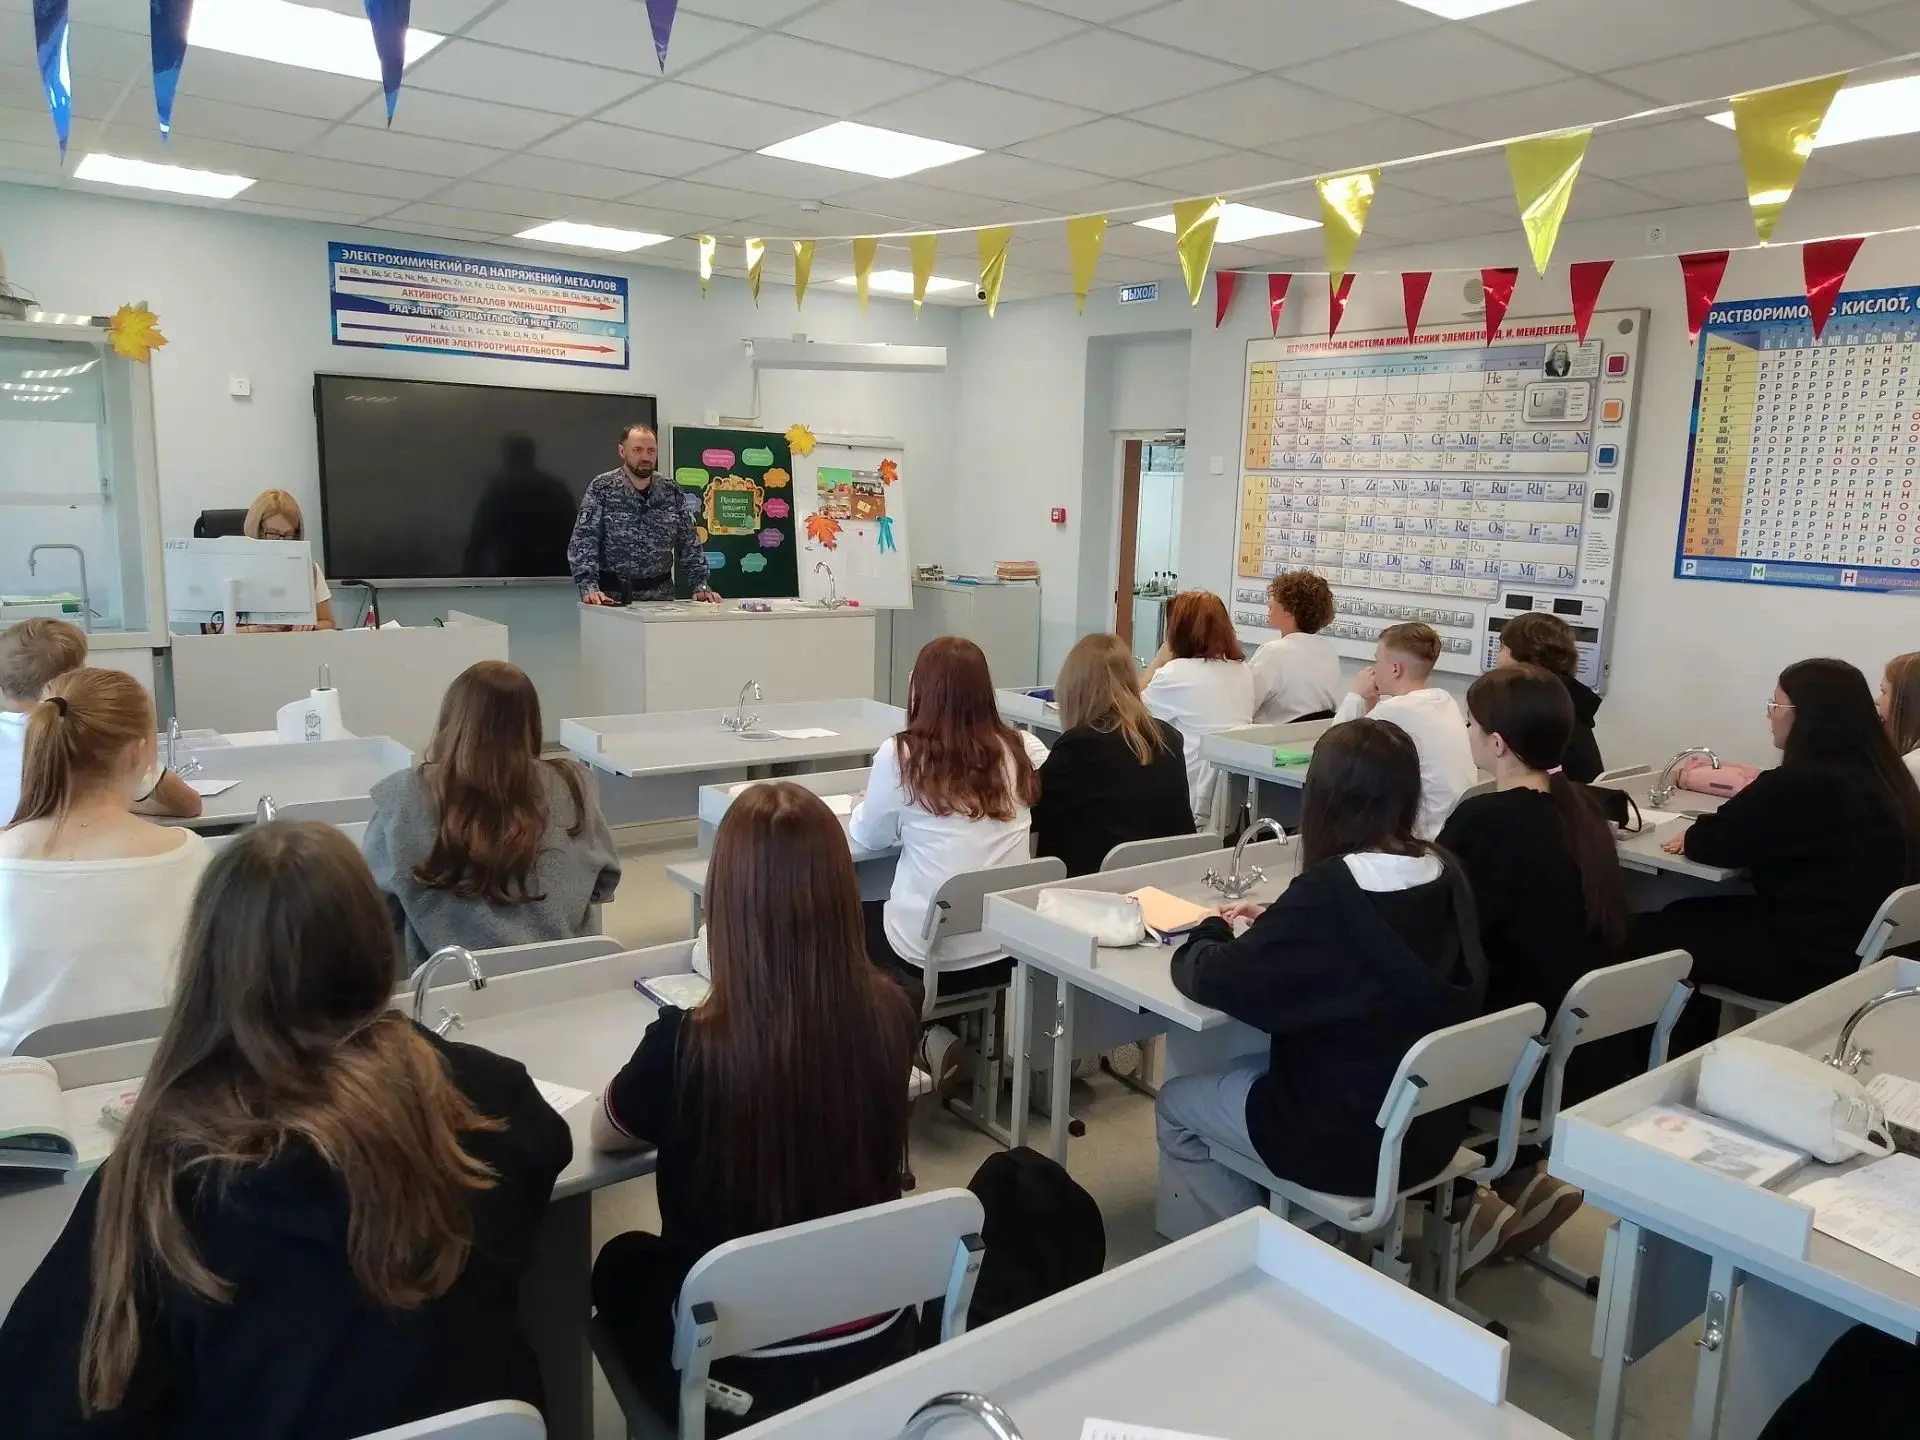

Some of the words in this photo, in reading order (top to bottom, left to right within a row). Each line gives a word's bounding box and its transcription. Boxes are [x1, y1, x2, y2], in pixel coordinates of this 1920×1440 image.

[342, 249, 462, 272] ЭЛЕКТРОХИМИЧЕКИЙ
[465, 264, 488, 276] РЯД
[490, 267, 562, 284] НАПРЯЖЕНИЙ
[564, 276, 616, 291] МЕТАЛЛОВ
[402, 289, 458, 302] АКТИВНОСТЬ
[460, 295, 506, 306] МЕТАЛЛОВ
[508, 300, 566, 314] УМЕНЬШАЕТСЯ
[1122, 286, 1154, 300] ВЫХОД
[1842, 297, 1910, 315] КИСЛОТ,
[389, 304, 409, 314] РЯД
[410, 305, 529, 326] ЭЛЕКТРООТРИЦАТЕЛЬНОСТИ
[531, 318, 578, 331] НЕМЕТАЛОВ
[406, 335, 449, 346] УСИЛЕНИЕ
[452, 339, 566, 356] ЭЛЕКТРООТРИЦАТЕЛЬНОСТИ
[1287, 340, 1347, 353] ПЕРИОДИЧЕСКАЯ
[1348, 338, 1385, 348] СИСТЕМА
[1386, 334, 1440, 345] ХИМИЕСКИХ
[1442, 330, 1487, 342] ЭЛЕМЕНТО
[1506, 328, 1514, 338] И.
[1516, 324, 1576, 337] МЕНДЕЛЕЕВА
[1486, 372, 1501, 384] He
[1534, 392, 1544, 407] U
[1482, 413, 1496, 424] Ar
[1460, 433, 1476, 445] Mn
[1500, 432, 1512, 444] Fe
[1532, 432, 1548, 444] Co
[1574, 432, 1589, 444] Ni
[1392, 480, 1407, 491] Nb
[1424, 481, 1439, 492] Mo
[1491, 482, 1506, 494] Ru
[1526, 482, 1542, 494] Rh
[1568, 484, 1582, 496] Pd
[1306, 495, 1318, 506] Cd
[1360, 516, 1374, 527] Hf
[1424, 519, 1435, 530] W
[1455, 520, 1468, 532] Re
[1488, 521, 1502, 534] Os
[1528, 524, 1539, 536] Ir
[1566, 525, 1578, 538] Pt
[1302, 531, 1315, 543] Hg
[1358, 552, 1371, 564] Rf
[1386, 554, 1400, 566] Db
[1420, 558, 1432, 571] Sg
[1450, 559, 1464, 571] Bh
[1484, 561, 1498, 573] Hs
[1520, 564, 1534, 576] Mt
[1558, 566, 1574, 579] Ds
[1754, 566, 1764, 576] М
[1844, 572, 1854, 583] Н
